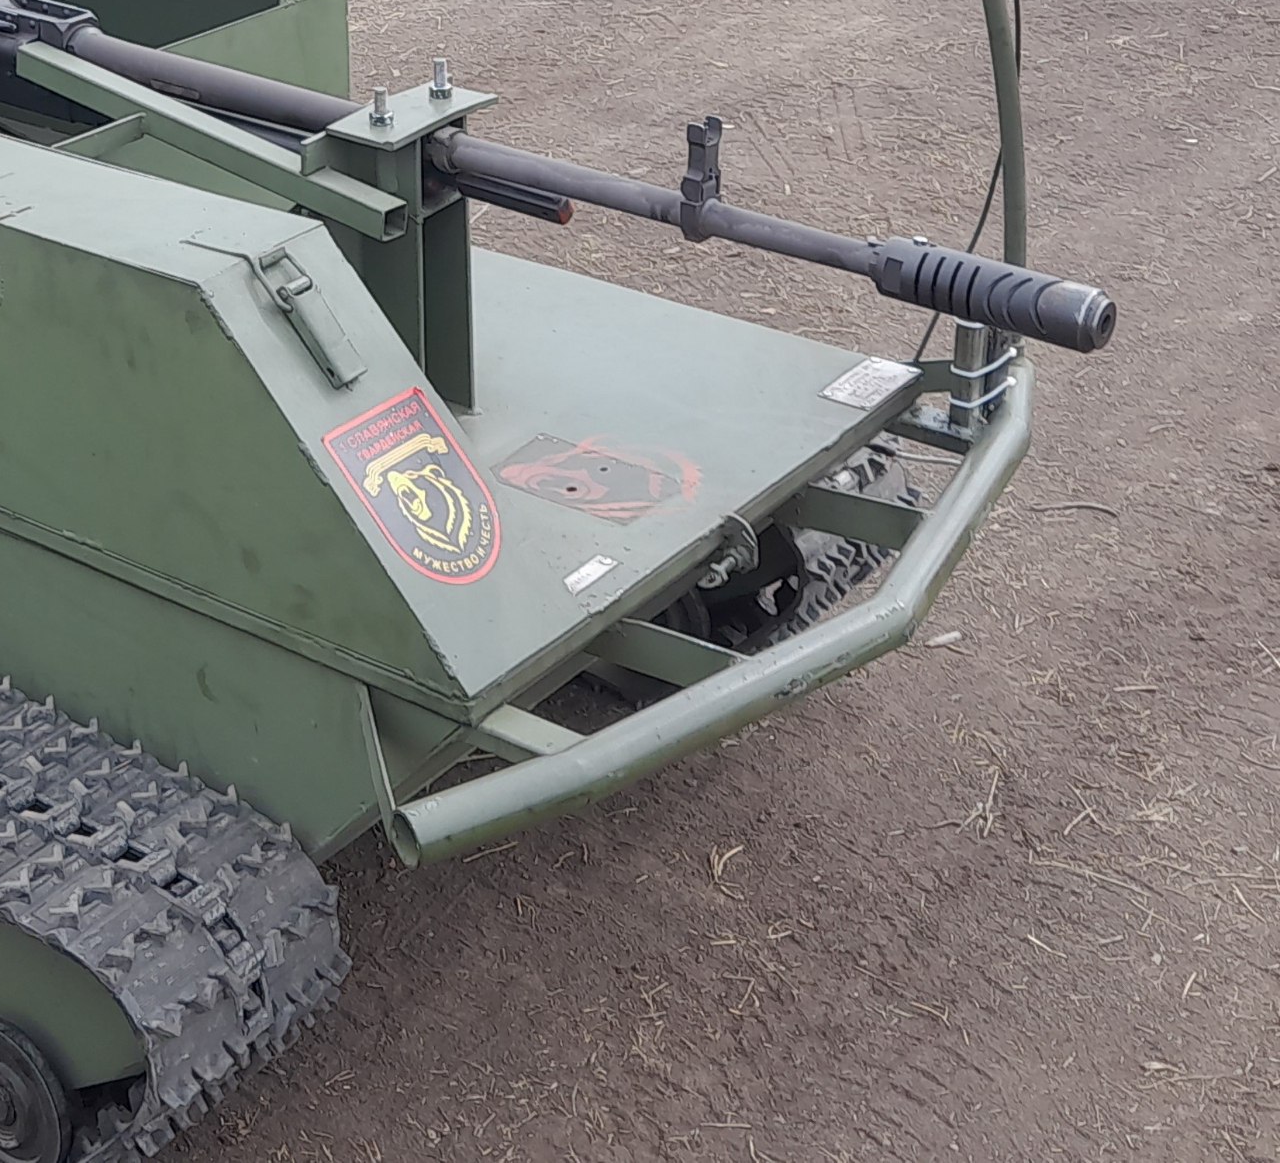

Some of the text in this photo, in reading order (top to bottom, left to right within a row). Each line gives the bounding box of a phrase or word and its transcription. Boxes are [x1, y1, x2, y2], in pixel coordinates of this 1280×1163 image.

[347, 401, 421, 449] СЛАВЯНСКАЯ
[412, 504, 491, 573] МУЖЕСТВО И ЧЕСТЬ
